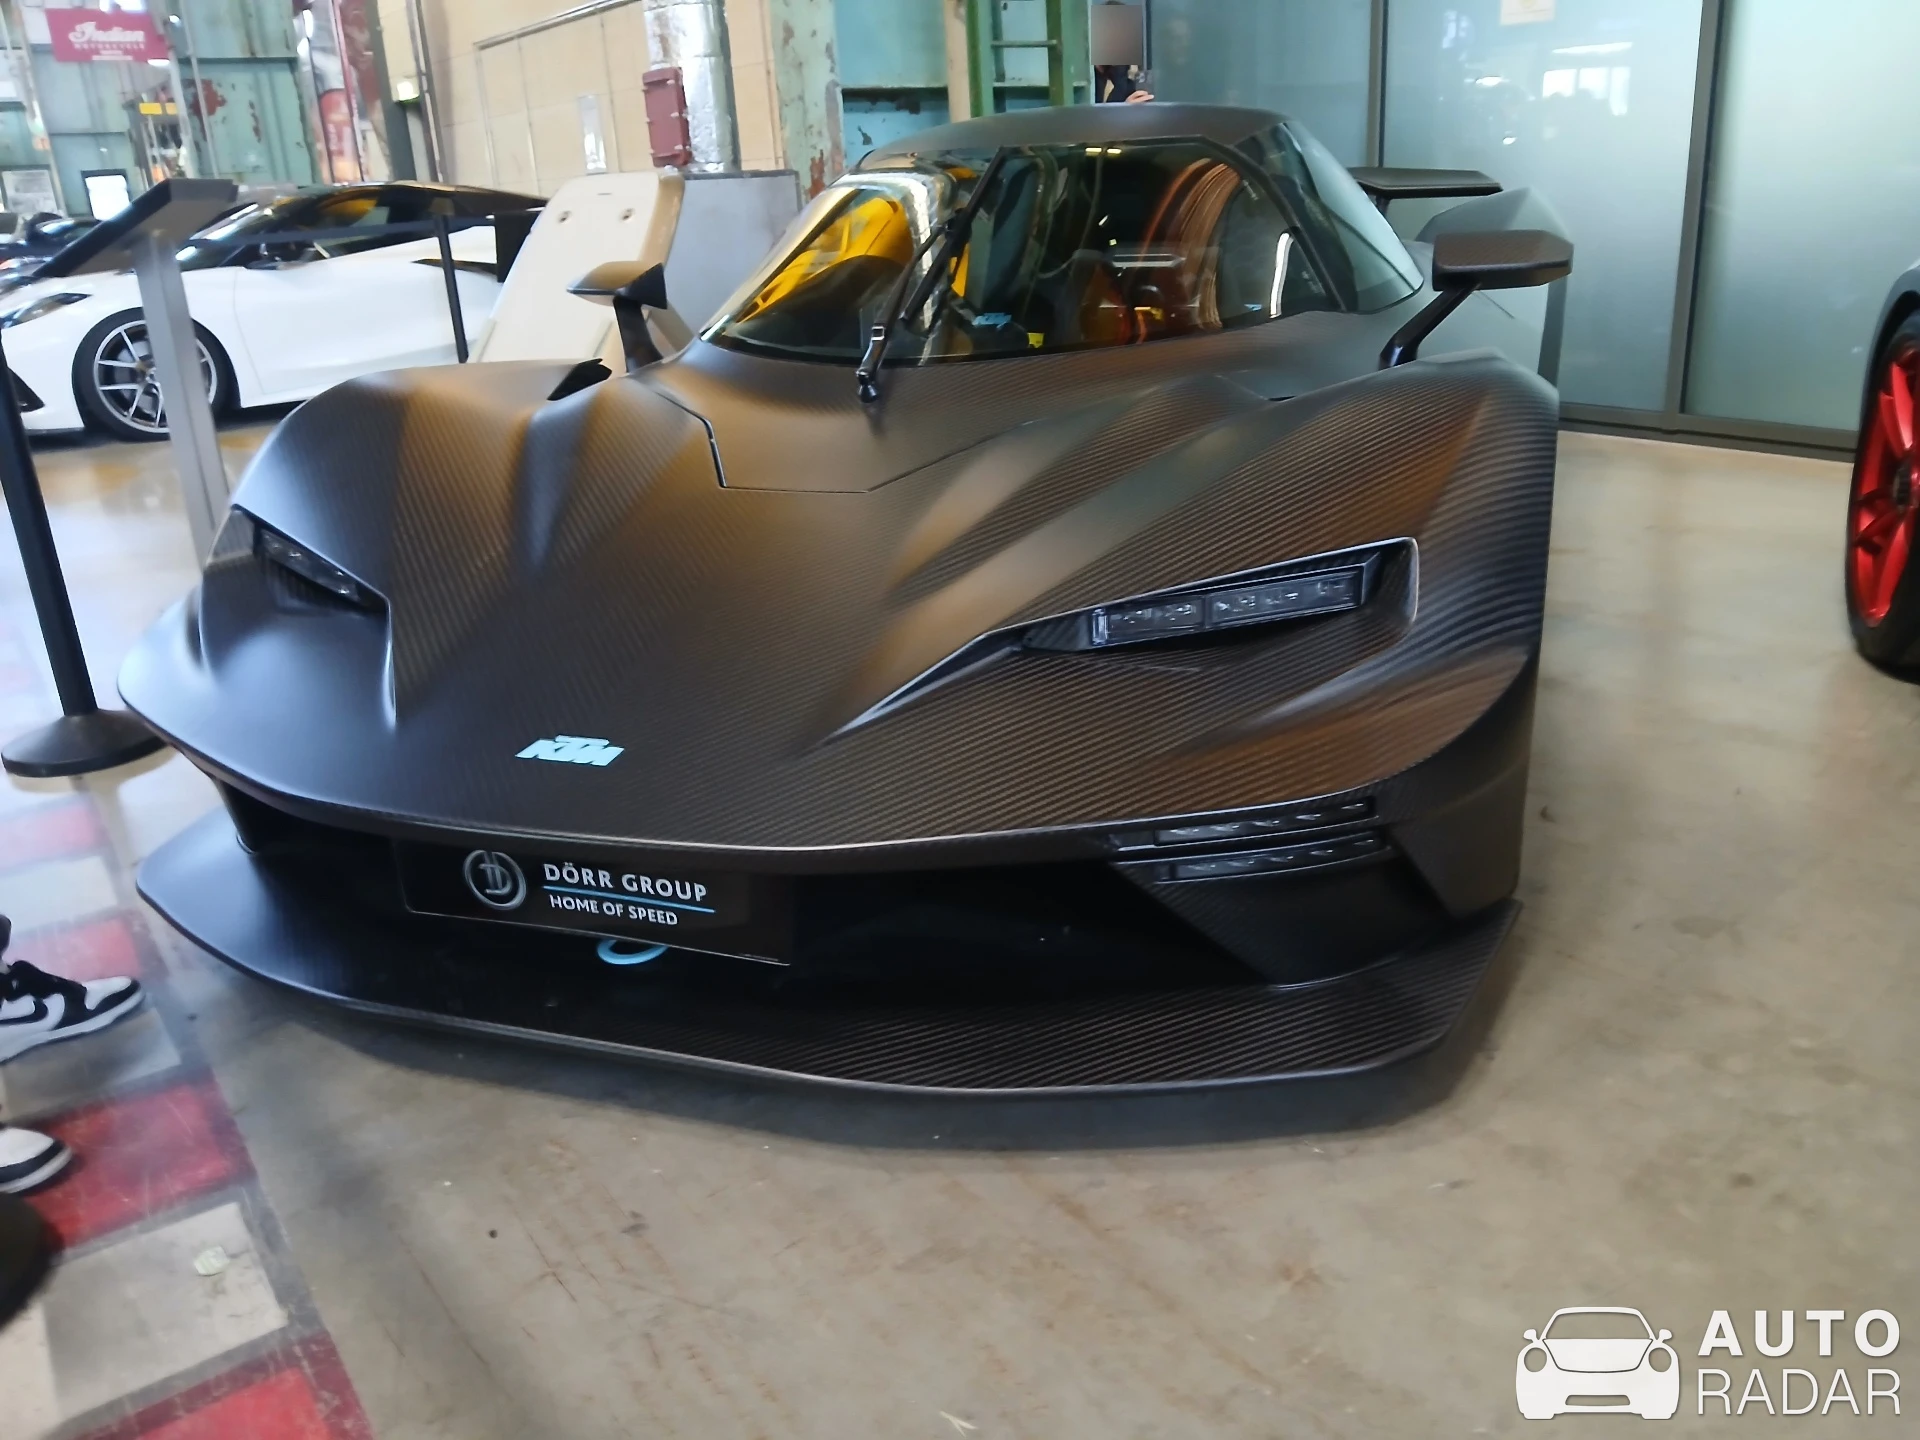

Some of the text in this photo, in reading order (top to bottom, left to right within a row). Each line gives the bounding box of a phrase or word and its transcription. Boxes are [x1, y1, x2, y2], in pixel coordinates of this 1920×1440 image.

[515, 734, 625, 767] KTM
[543, 861, 707, 902] DÖRR GROUP
[549, 894, 678, 926] HOME OF SPEED
